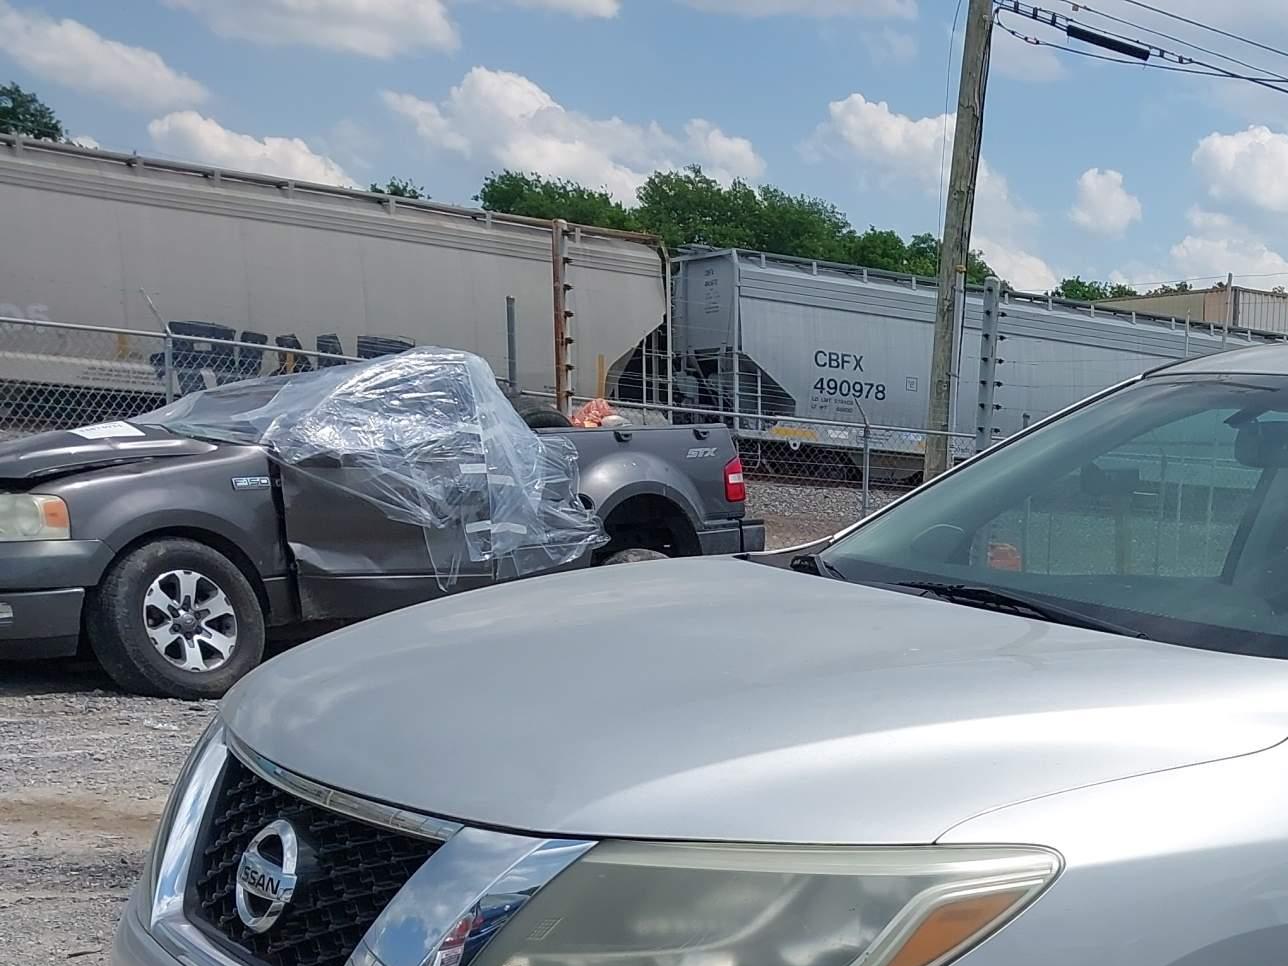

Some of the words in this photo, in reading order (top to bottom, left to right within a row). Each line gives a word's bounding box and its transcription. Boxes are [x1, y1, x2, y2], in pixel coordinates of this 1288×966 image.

[814, 350, 864, 372] CBFX
[813, 378, 886, 400] 490978
[686, 447, 717, 458] STX
